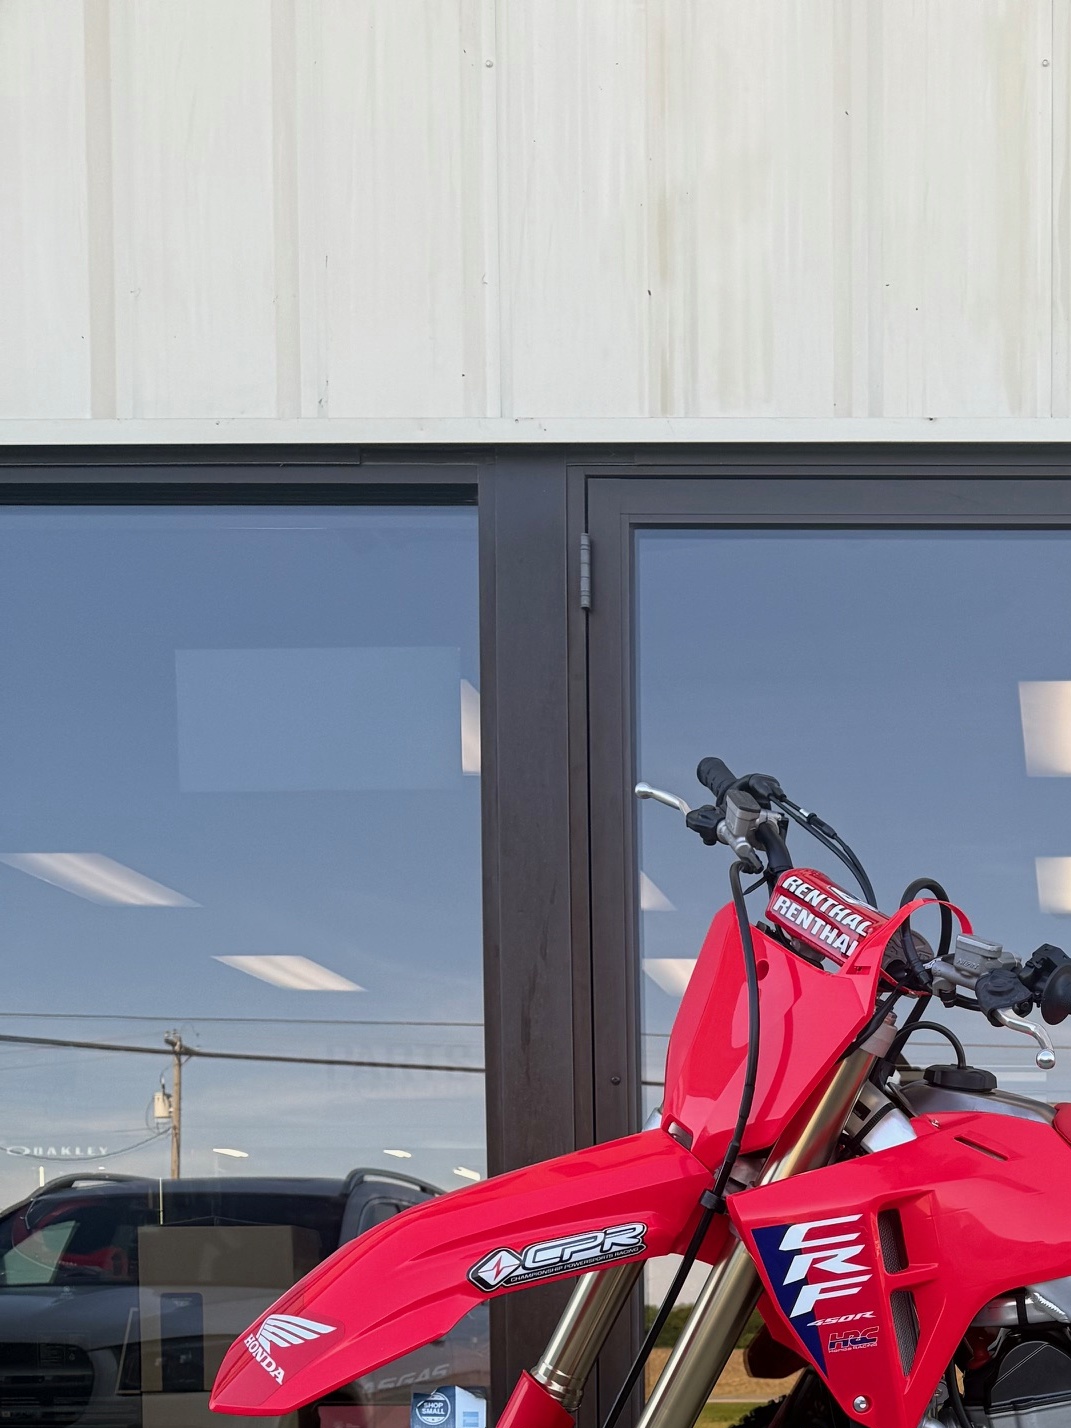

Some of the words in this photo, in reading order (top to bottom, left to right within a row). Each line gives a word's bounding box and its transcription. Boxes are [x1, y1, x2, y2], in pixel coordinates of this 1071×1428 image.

[783, 875, 873, 938] RENTHAL
[33, 1147, 108, 1156] OAKLEY
[510, 1265, 563, 1283] CHAMPIONSHIP
[563, 1253, 614, 1271] POWERSPORTS
[614, 1246, 640, 1258] RACING
[523, 1222, 645, 1270] CPR
[779, 1214, 872, 1318] CRF
[806, 1311, 877, 1327] 450R
[828, 1326, 879, 1350] HRC
[244, 1333, 285, 1385] HONDA
